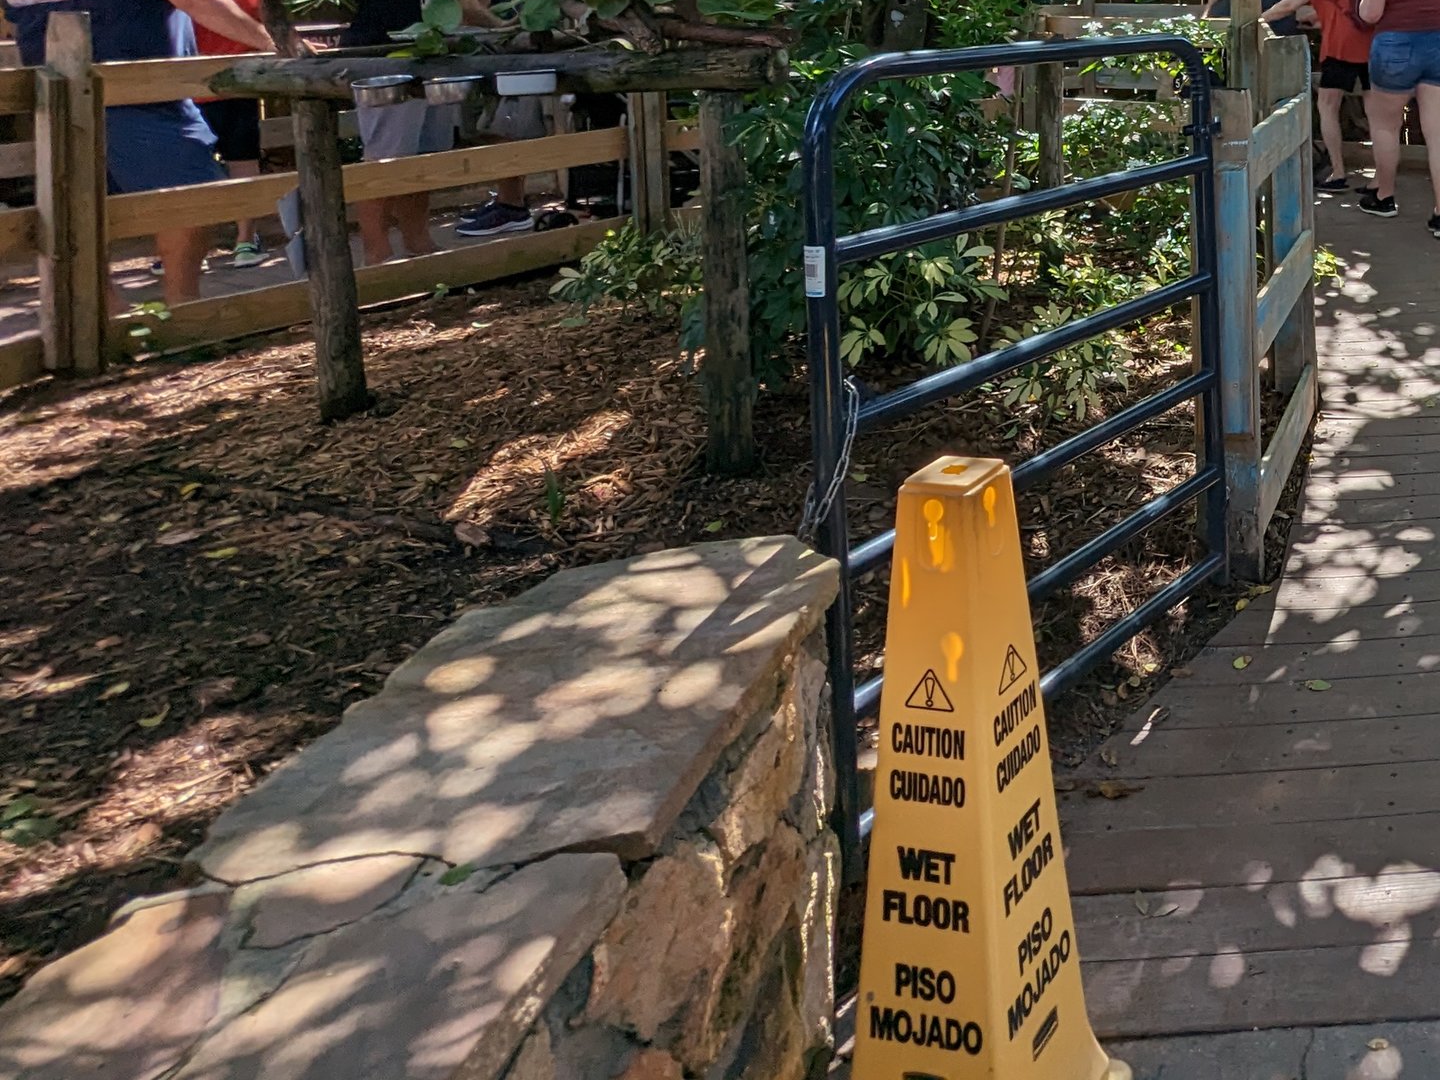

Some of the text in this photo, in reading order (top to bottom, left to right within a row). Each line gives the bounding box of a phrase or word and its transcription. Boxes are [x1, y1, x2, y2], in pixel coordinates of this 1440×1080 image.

[891, 722, 965, 761] CAUTION
[993, 679, 1037, 748] CAUTION
[996, 724, 1041, 794] CUIDADO
[889, 769, 966, 808] CUIDADO
[1007, 797, 1041, 862] WET
[896, 845, 956, 885] WET
[1003, 831, 1054, 918] FLOOR
[882, 888, 969, 934] FLOOR
[1017, 906, 1053, 977] PISO
[894, 962, 956, 1005] PISO
[1007, 929, 1071, 1042] MOJADO
[869, 1005, 983, 1056] MOJADO
